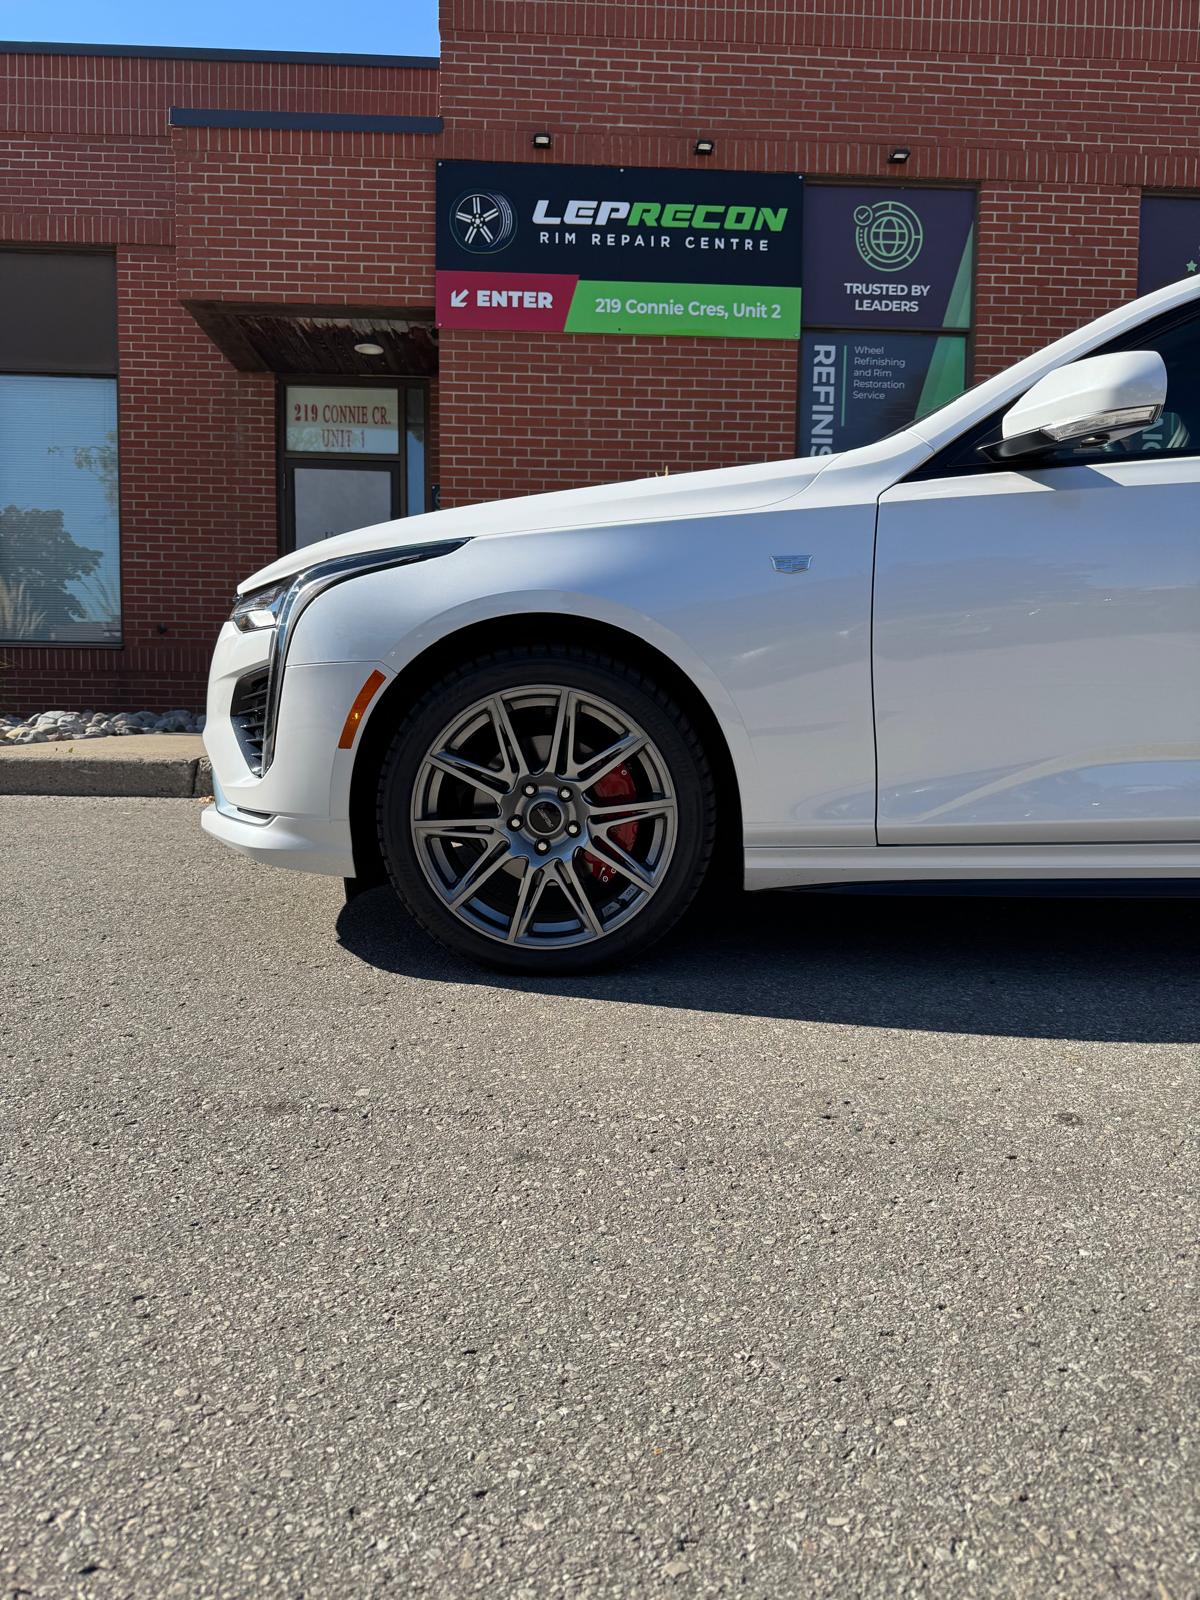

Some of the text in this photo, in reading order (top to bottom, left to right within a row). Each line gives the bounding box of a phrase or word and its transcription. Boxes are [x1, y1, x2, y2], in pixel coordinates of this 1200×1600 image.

[532, 200, 788, 232] LEPRECON
[540, 232, 769, 251] RIM REPAIR CENTRE
[844, 283, 931, 297] TRUSTED BY
[476, 290, 553, 309] ENTER
[855, 300, 919, 313] LEADERS
[595, 298, 782, 320] 219 Connie Cres, Unit 2
[854, 345, 885, 355] Wheel
[854, 357, 906, 368] Refinishing
[853, 368, 892, 377] and Rim
[853, 379, 905, 389] Restoration
[852, 390, 886, 400] Service
[294, 404, 392, 425] 219 CONNIE CR.
[322, 429, 366, 448] UNIT 1
